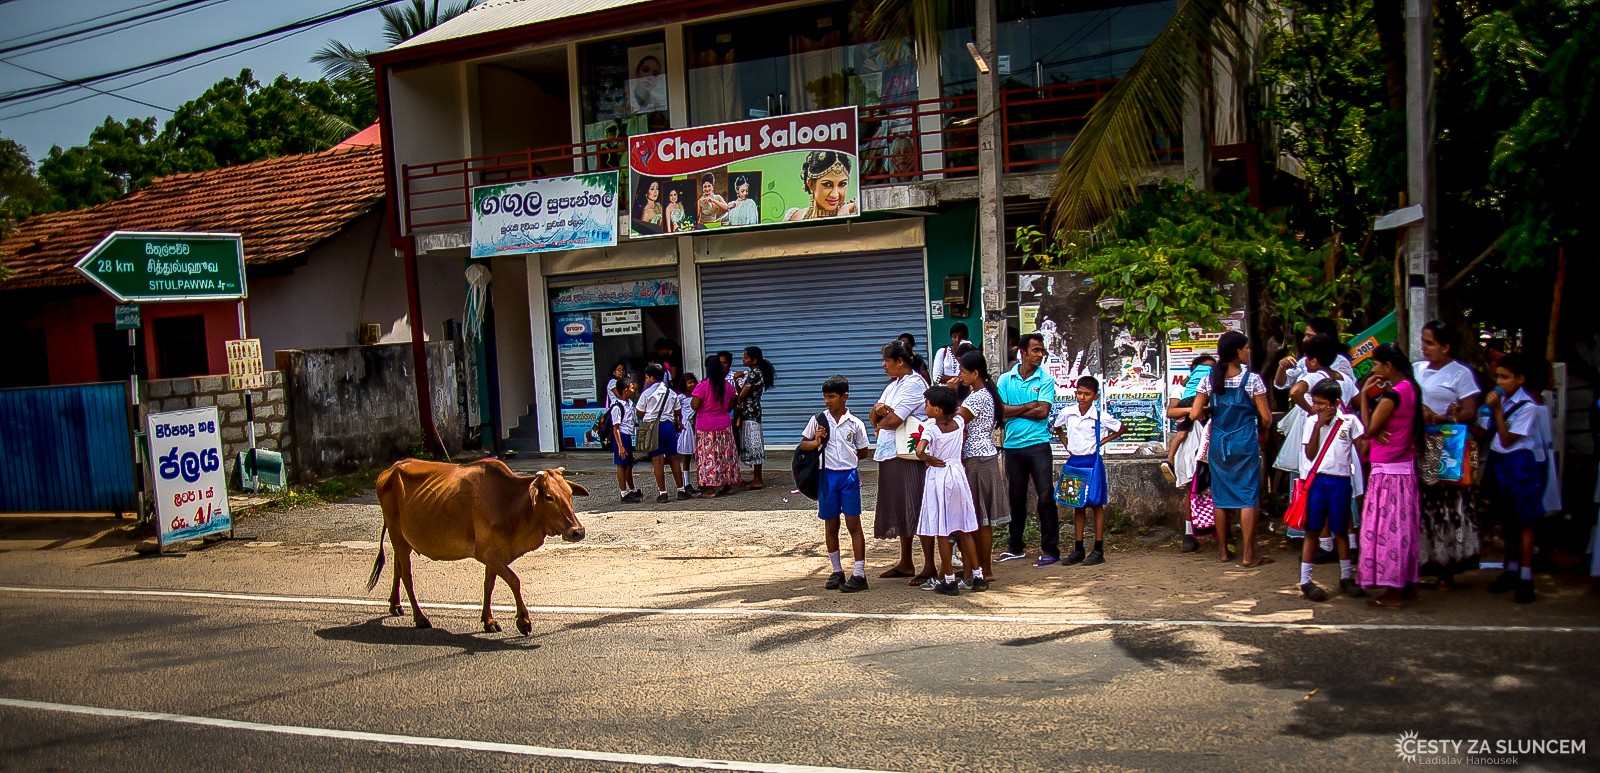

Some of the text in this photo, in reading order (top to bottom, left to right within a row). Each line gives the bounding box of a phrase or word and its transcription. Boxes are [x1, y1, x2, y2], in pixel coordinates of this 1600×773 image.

[657, 121, 848, 163] Chathu Saloon
[98, 260, 134, 272] 28 km
[149, 280, 215, 290] SITULPAWWA
[158, 446, 220, 483] ජලය
